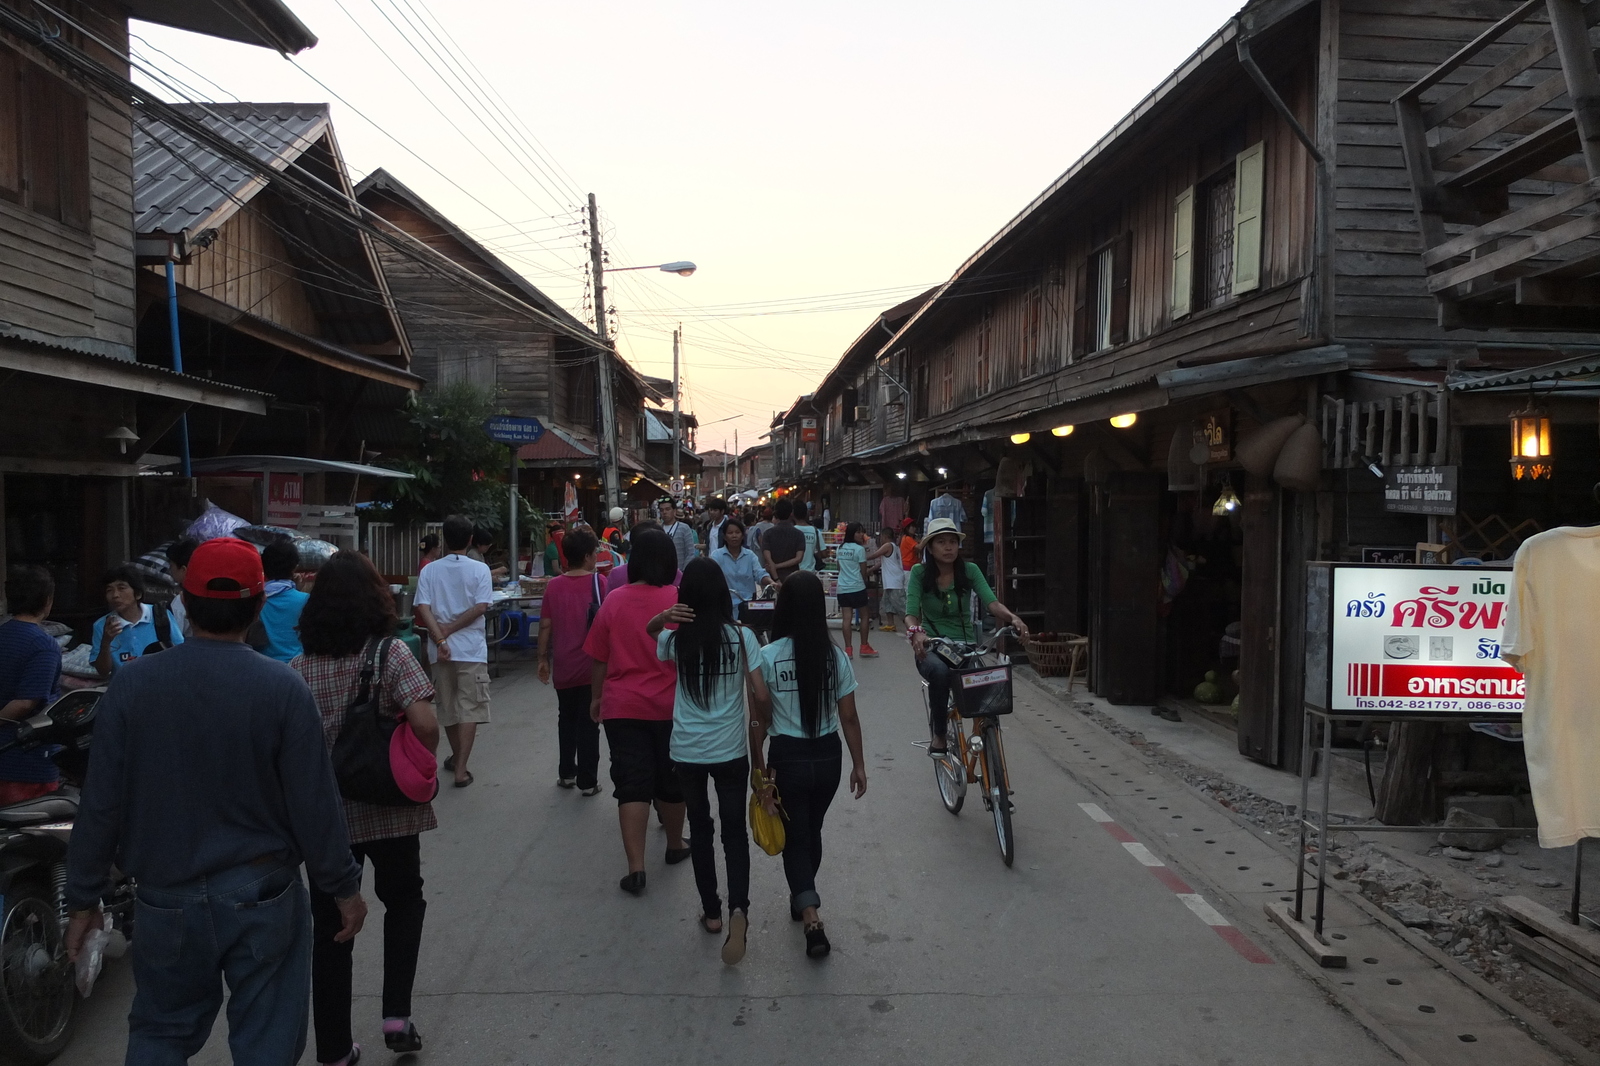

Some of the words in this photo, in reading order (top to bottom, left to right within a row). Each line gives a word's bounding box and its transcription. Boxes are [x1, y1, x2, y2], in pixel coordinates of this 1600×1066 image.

[283, 481, 300, 499] ATM
[1472, 577, 1506, 595] เปิด
[1345, 591, 1386, 618] ครัว
[1408, 674, 1526, 695] อาหารตามส
